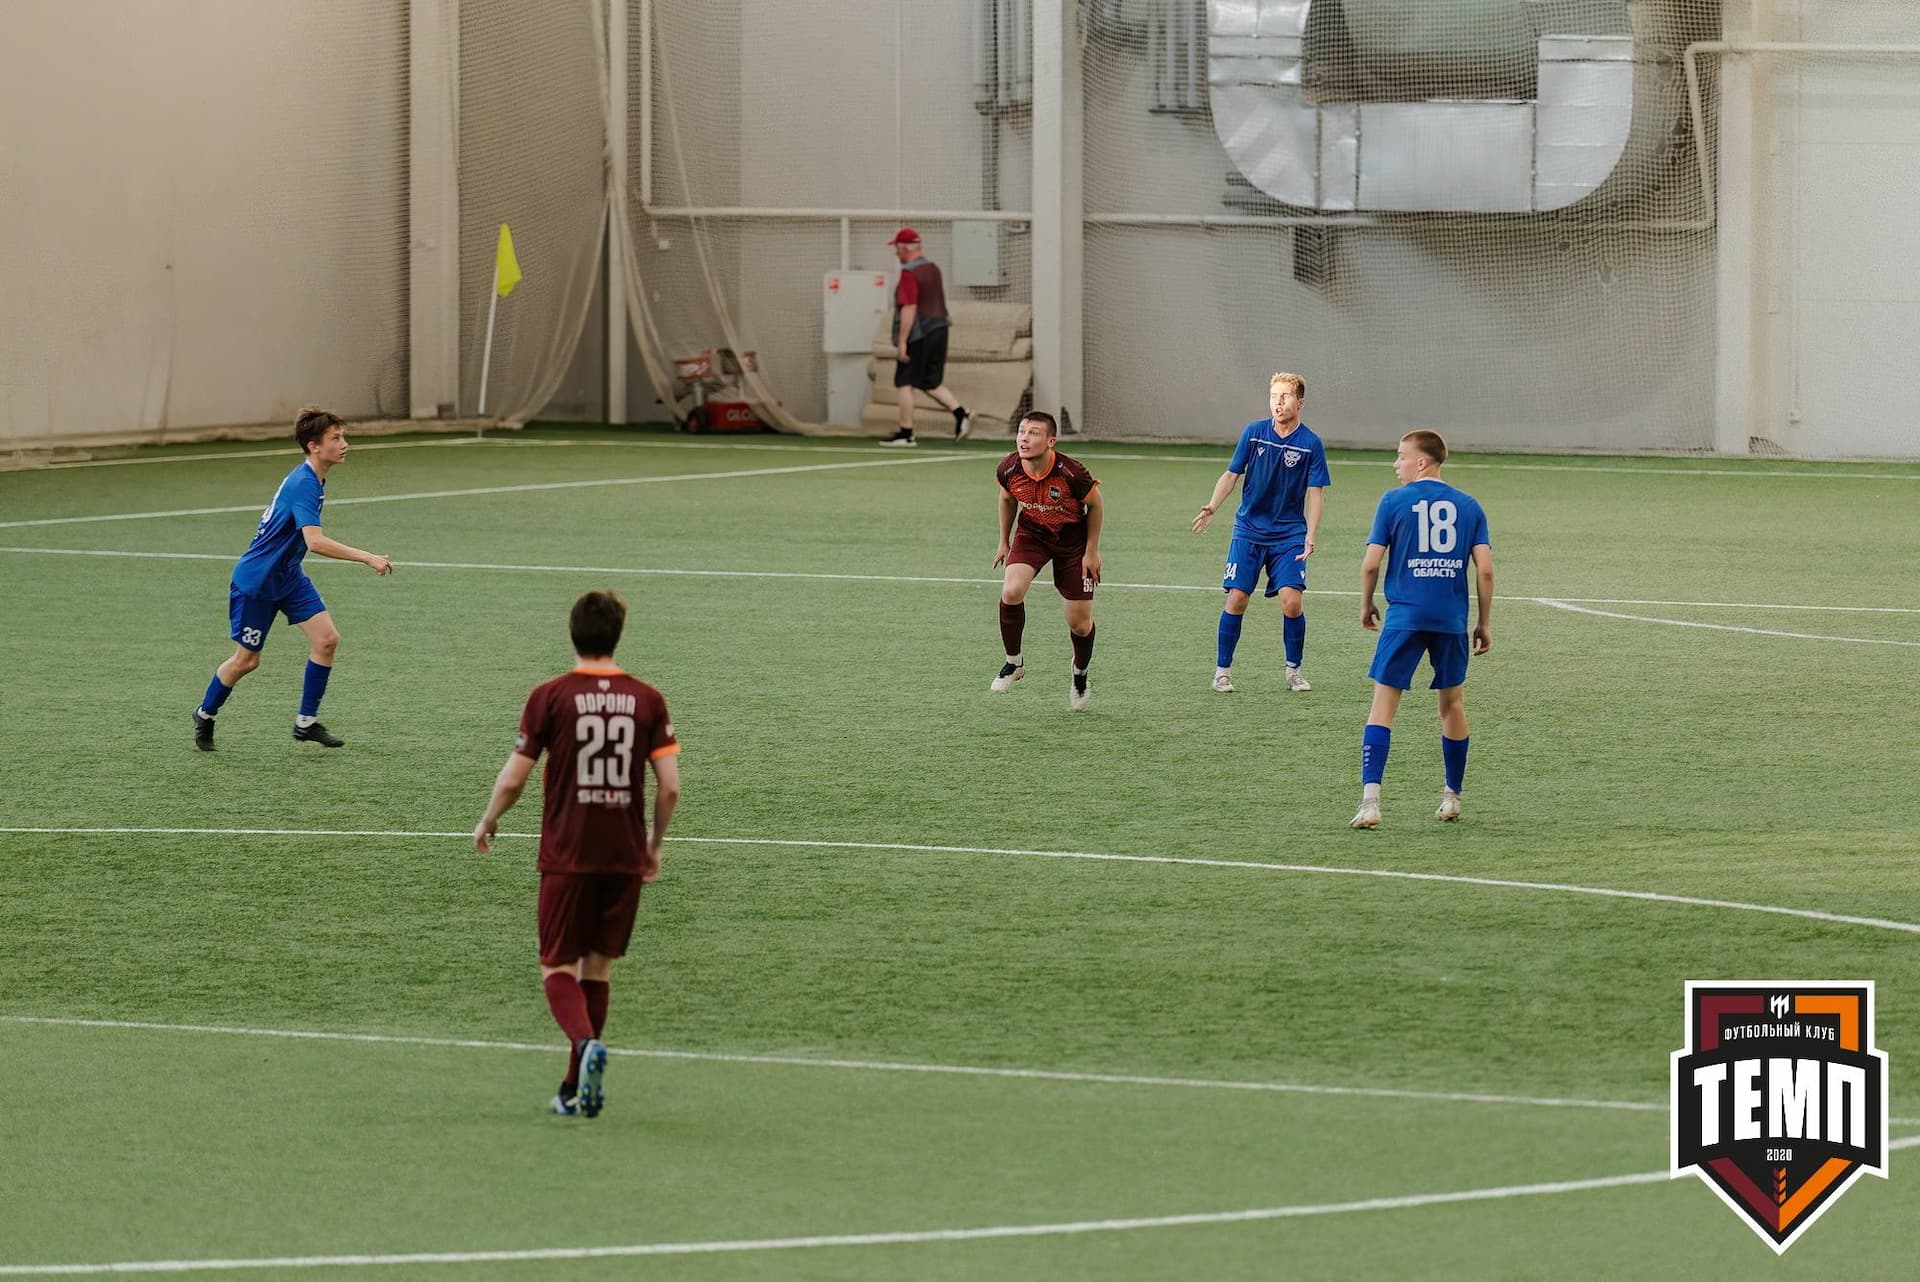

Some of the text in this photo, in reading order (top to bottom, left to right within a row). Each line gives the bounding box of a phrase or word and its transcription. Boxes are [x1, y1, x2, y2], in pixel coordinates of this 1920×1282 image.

[1412, 500, 1458, 553] 18
[1223, 562, 1237, 580] 34
[1408, 558, 1463, 569] ИРКУТСКАЯ
[1413, 568, 1457, 578] ОБЛАСТЬ
[242, 626, 262, 646] 33
[576, 715, 635, 788] 23
